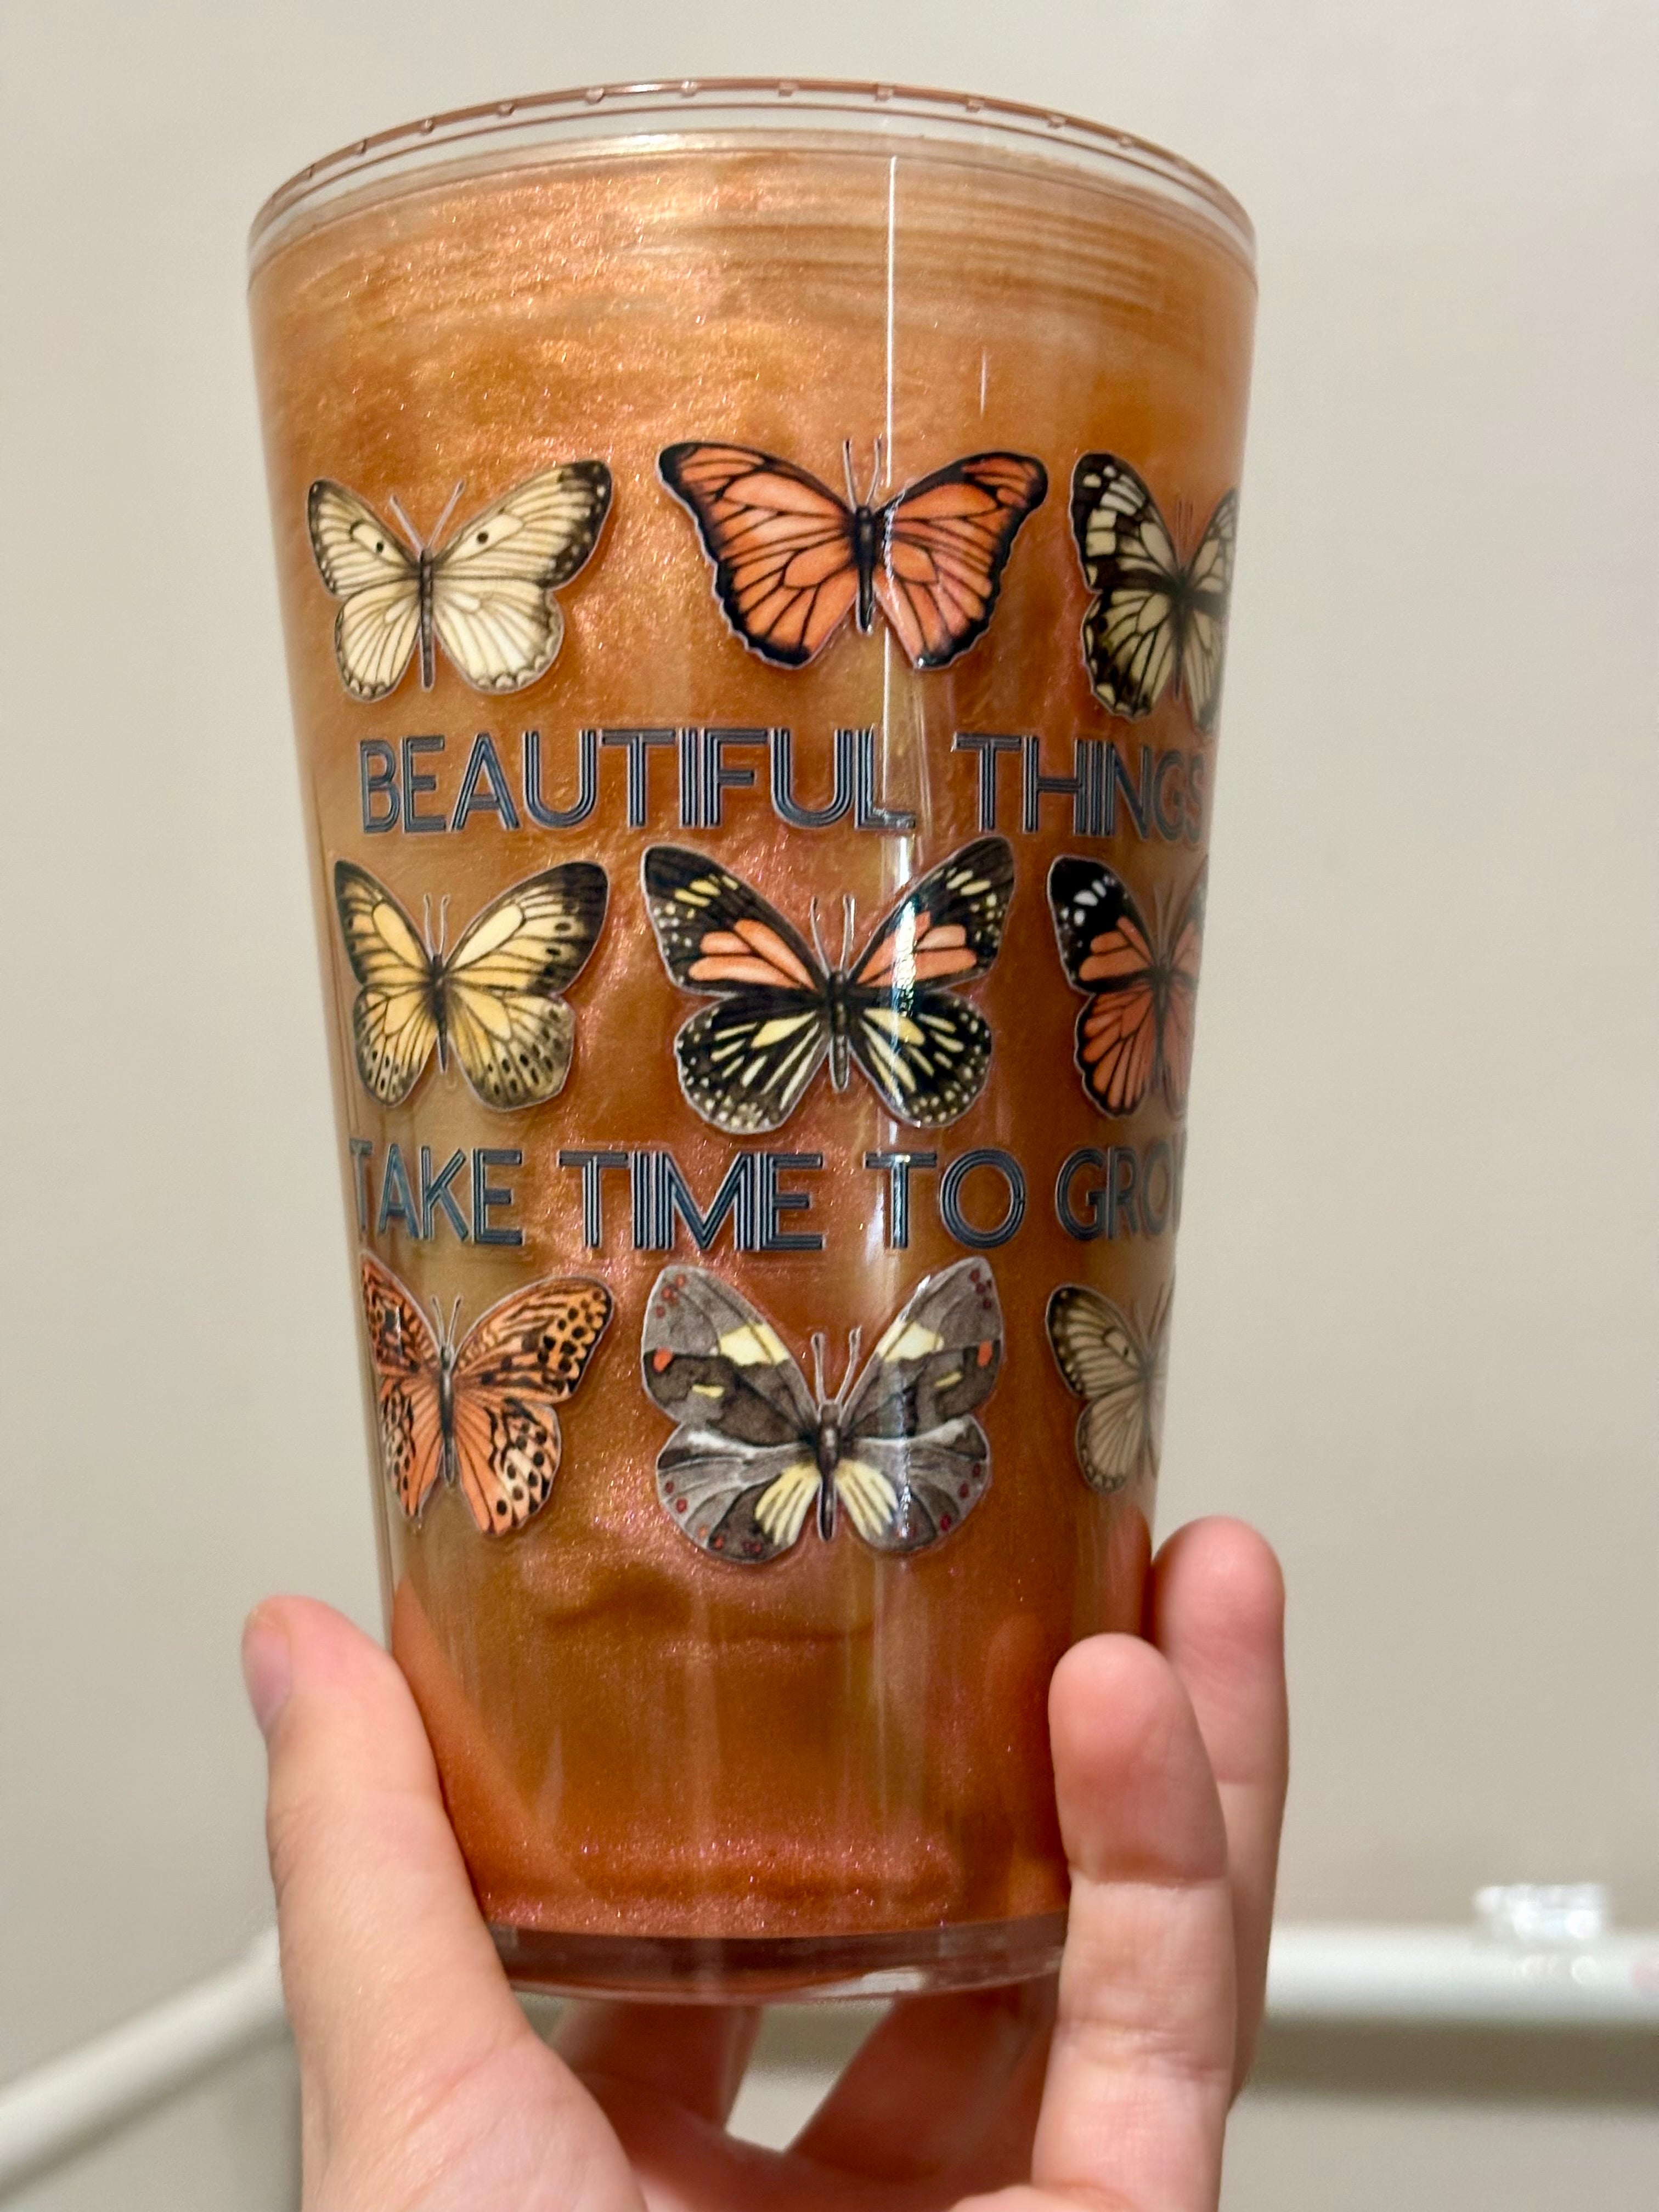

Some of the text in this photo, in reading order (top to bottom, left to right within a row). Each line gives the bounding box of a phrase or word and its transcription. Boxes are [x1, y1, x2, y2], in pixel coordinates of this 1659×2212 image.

[359, 728, 1207, 845] BEAUTIFUL THINGS
[349, 1138, 1182, 1251] TAKE TIME TO GRO
